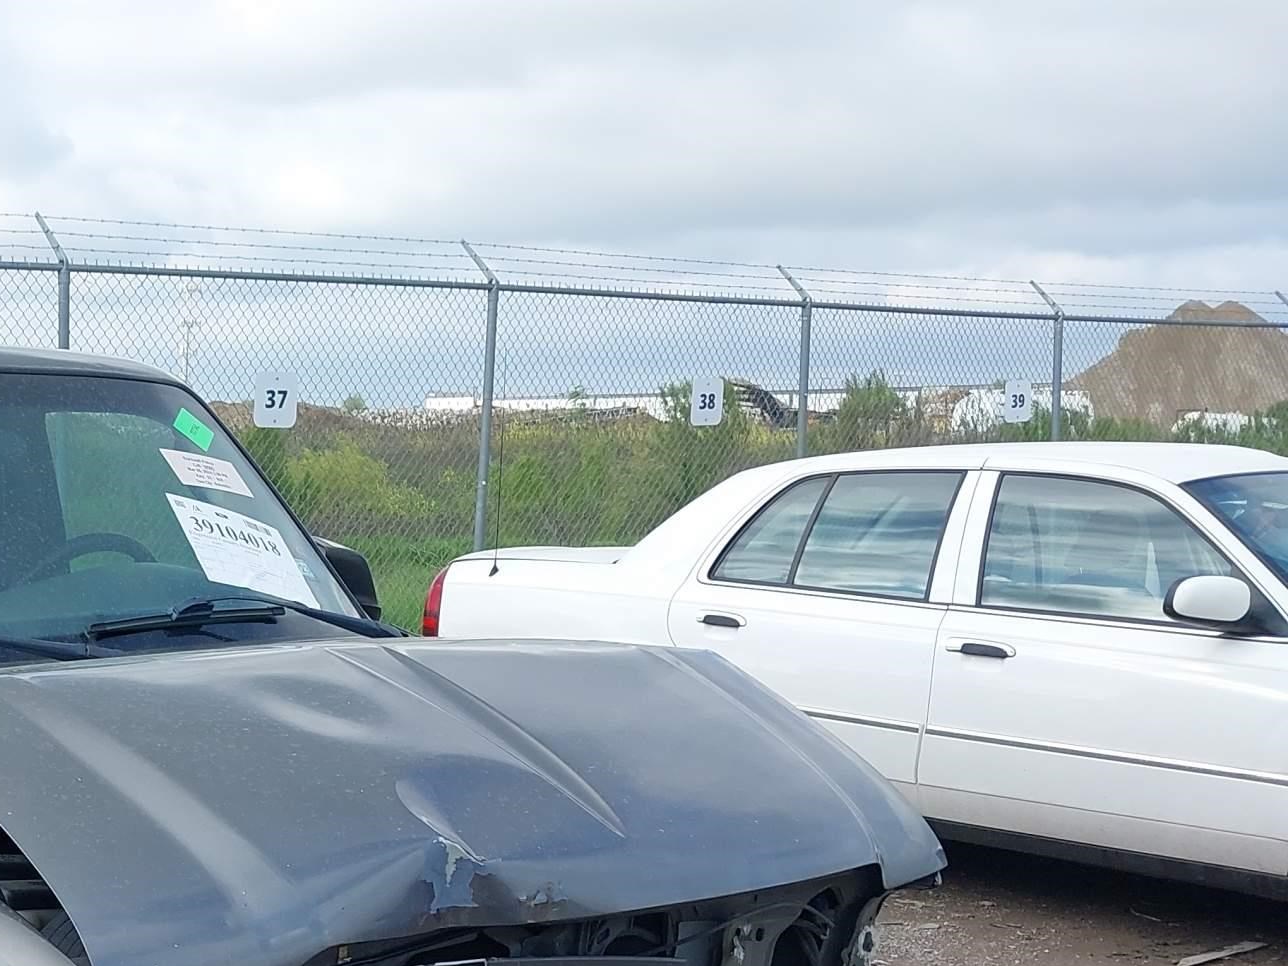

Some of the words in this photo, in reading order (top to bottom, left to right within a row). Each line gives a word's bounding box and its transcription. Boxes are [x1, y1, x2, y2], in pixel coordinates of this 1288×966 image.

[264, 389, 288, 409] 37
[698, 393, 716, 410] 38
[1011, 393, 1026, 409] 39
[189, 516, 281, 556] 39104018
